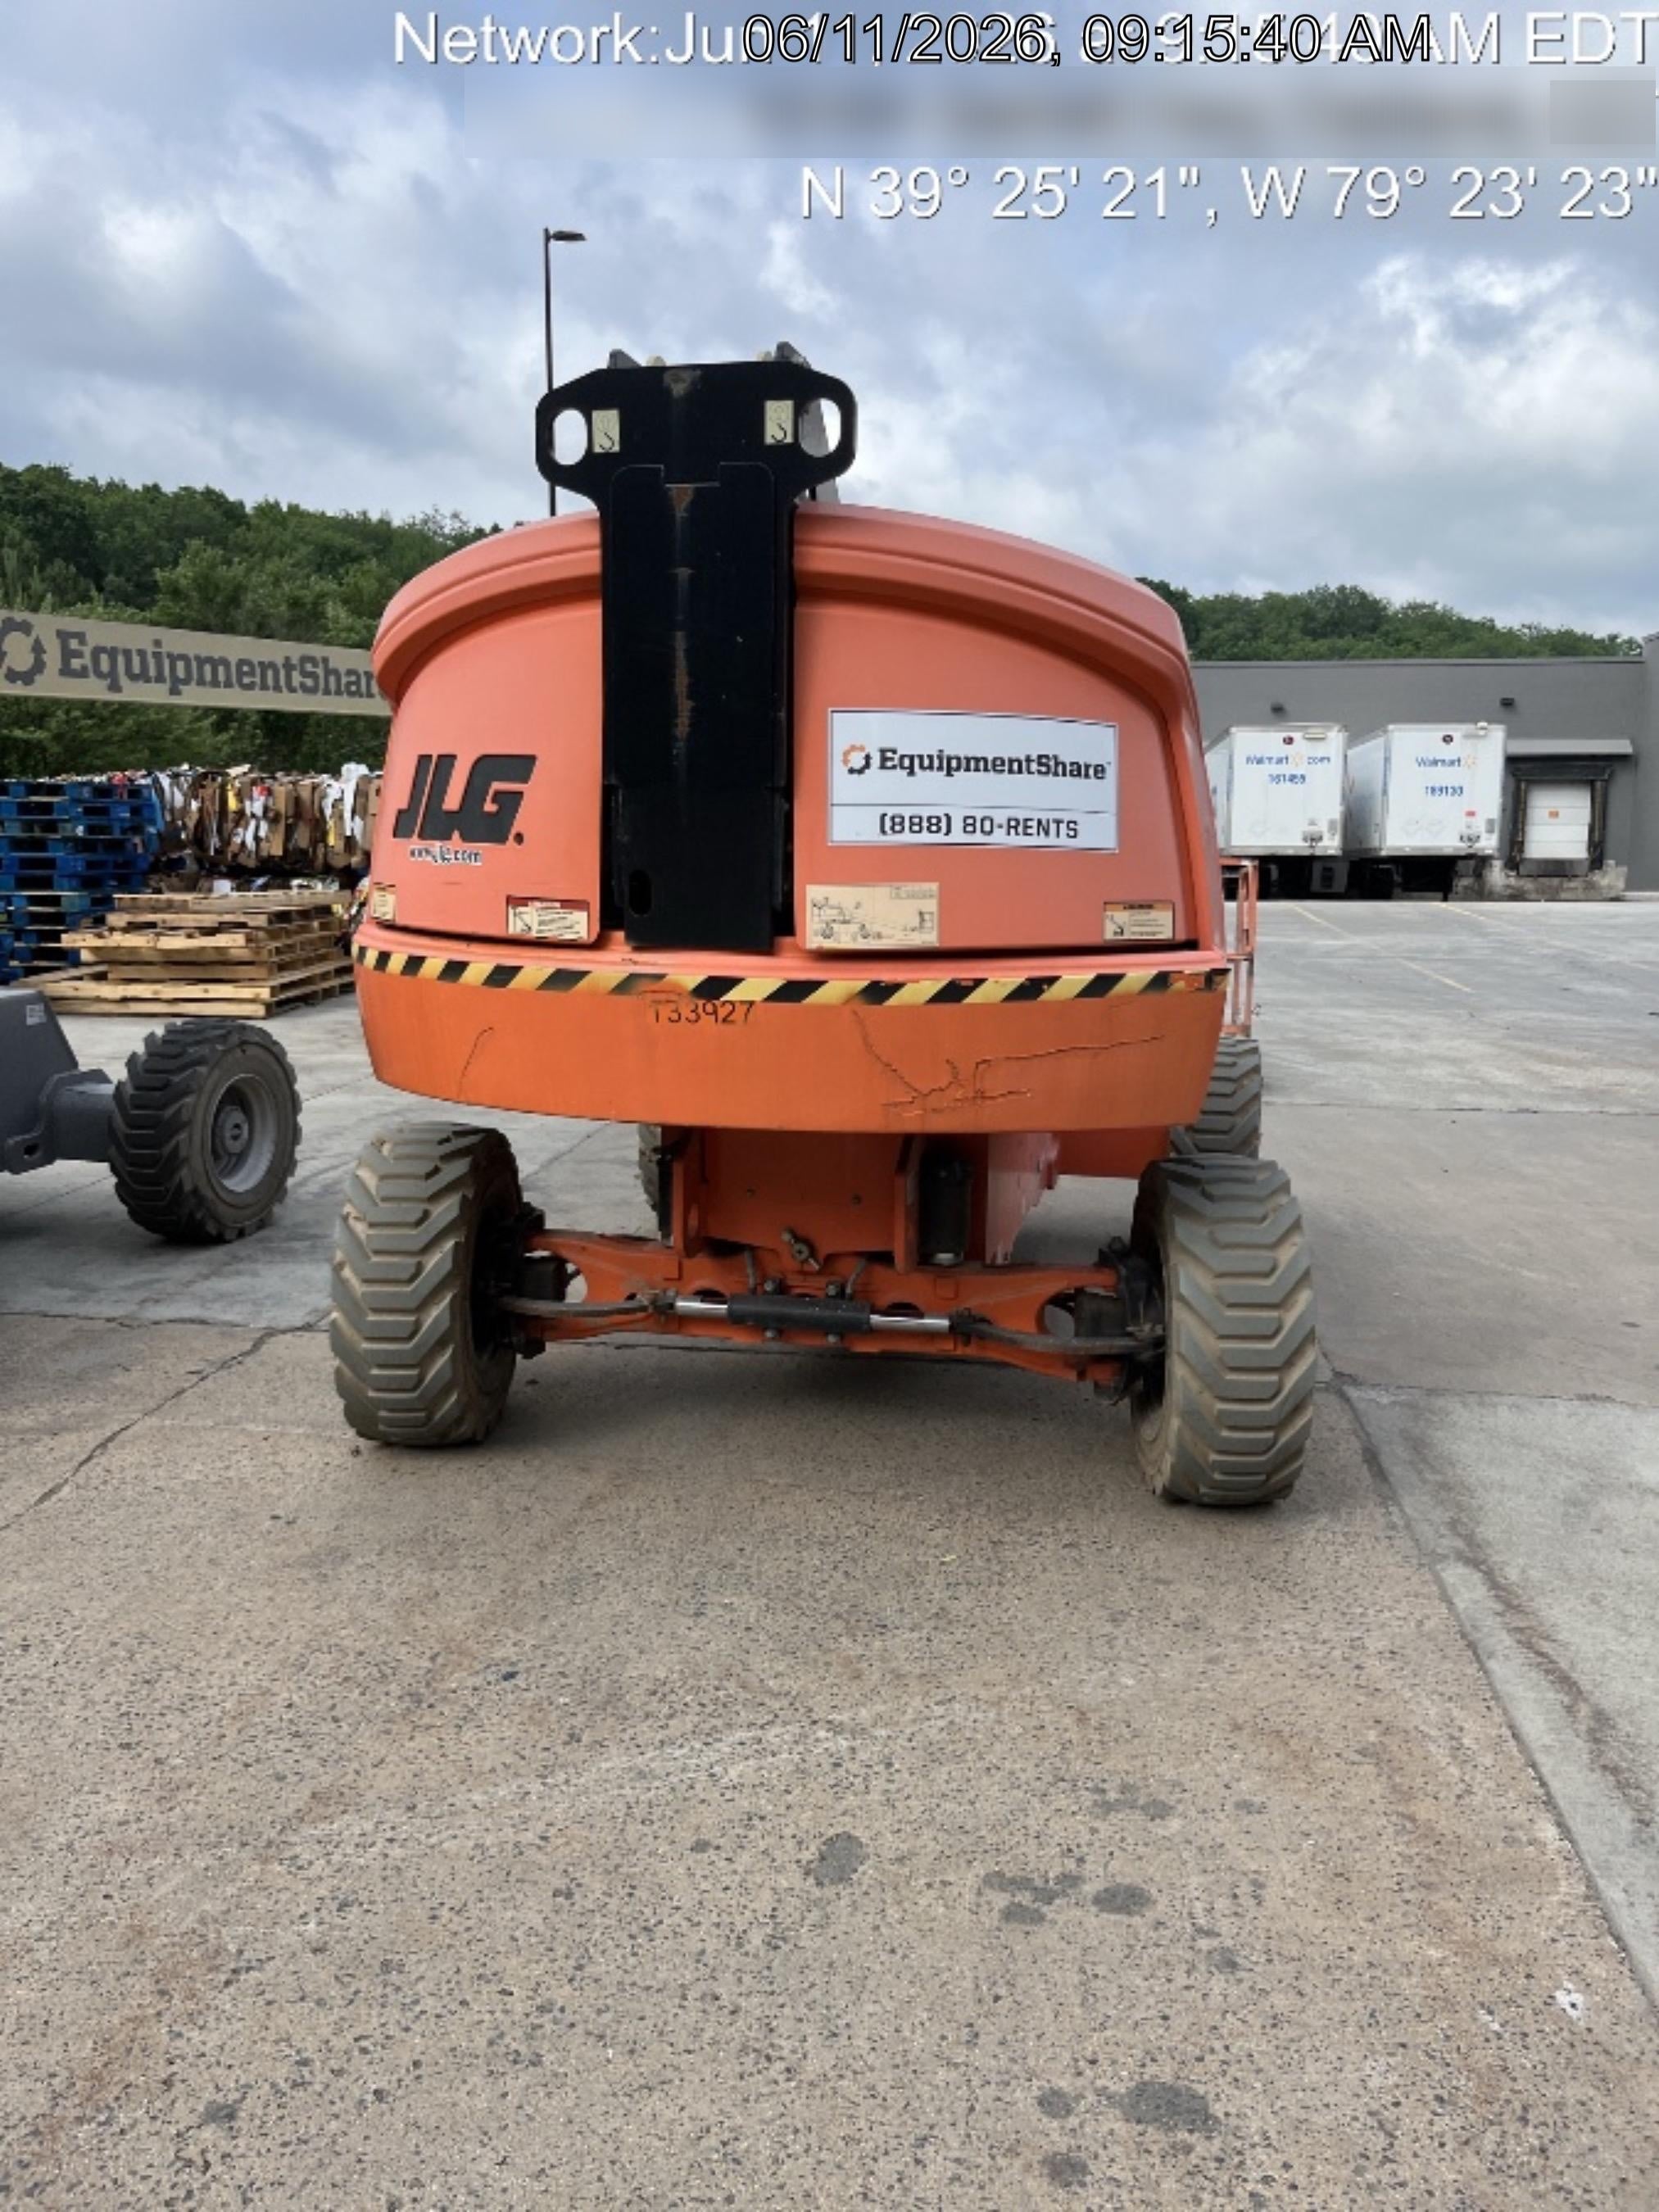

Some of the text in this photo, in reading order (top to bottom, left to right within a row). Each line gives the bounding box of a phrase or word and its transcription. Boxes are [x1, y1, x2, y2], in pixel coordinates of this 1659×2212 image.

[56, 628, 383, 700] EquipmentShar
[878, 748, 1106, 780] EquipmentShare
[1416, 756, 1461, 768] Walmart
[880, 813, 1078, 839] (888) 80-RENTS
